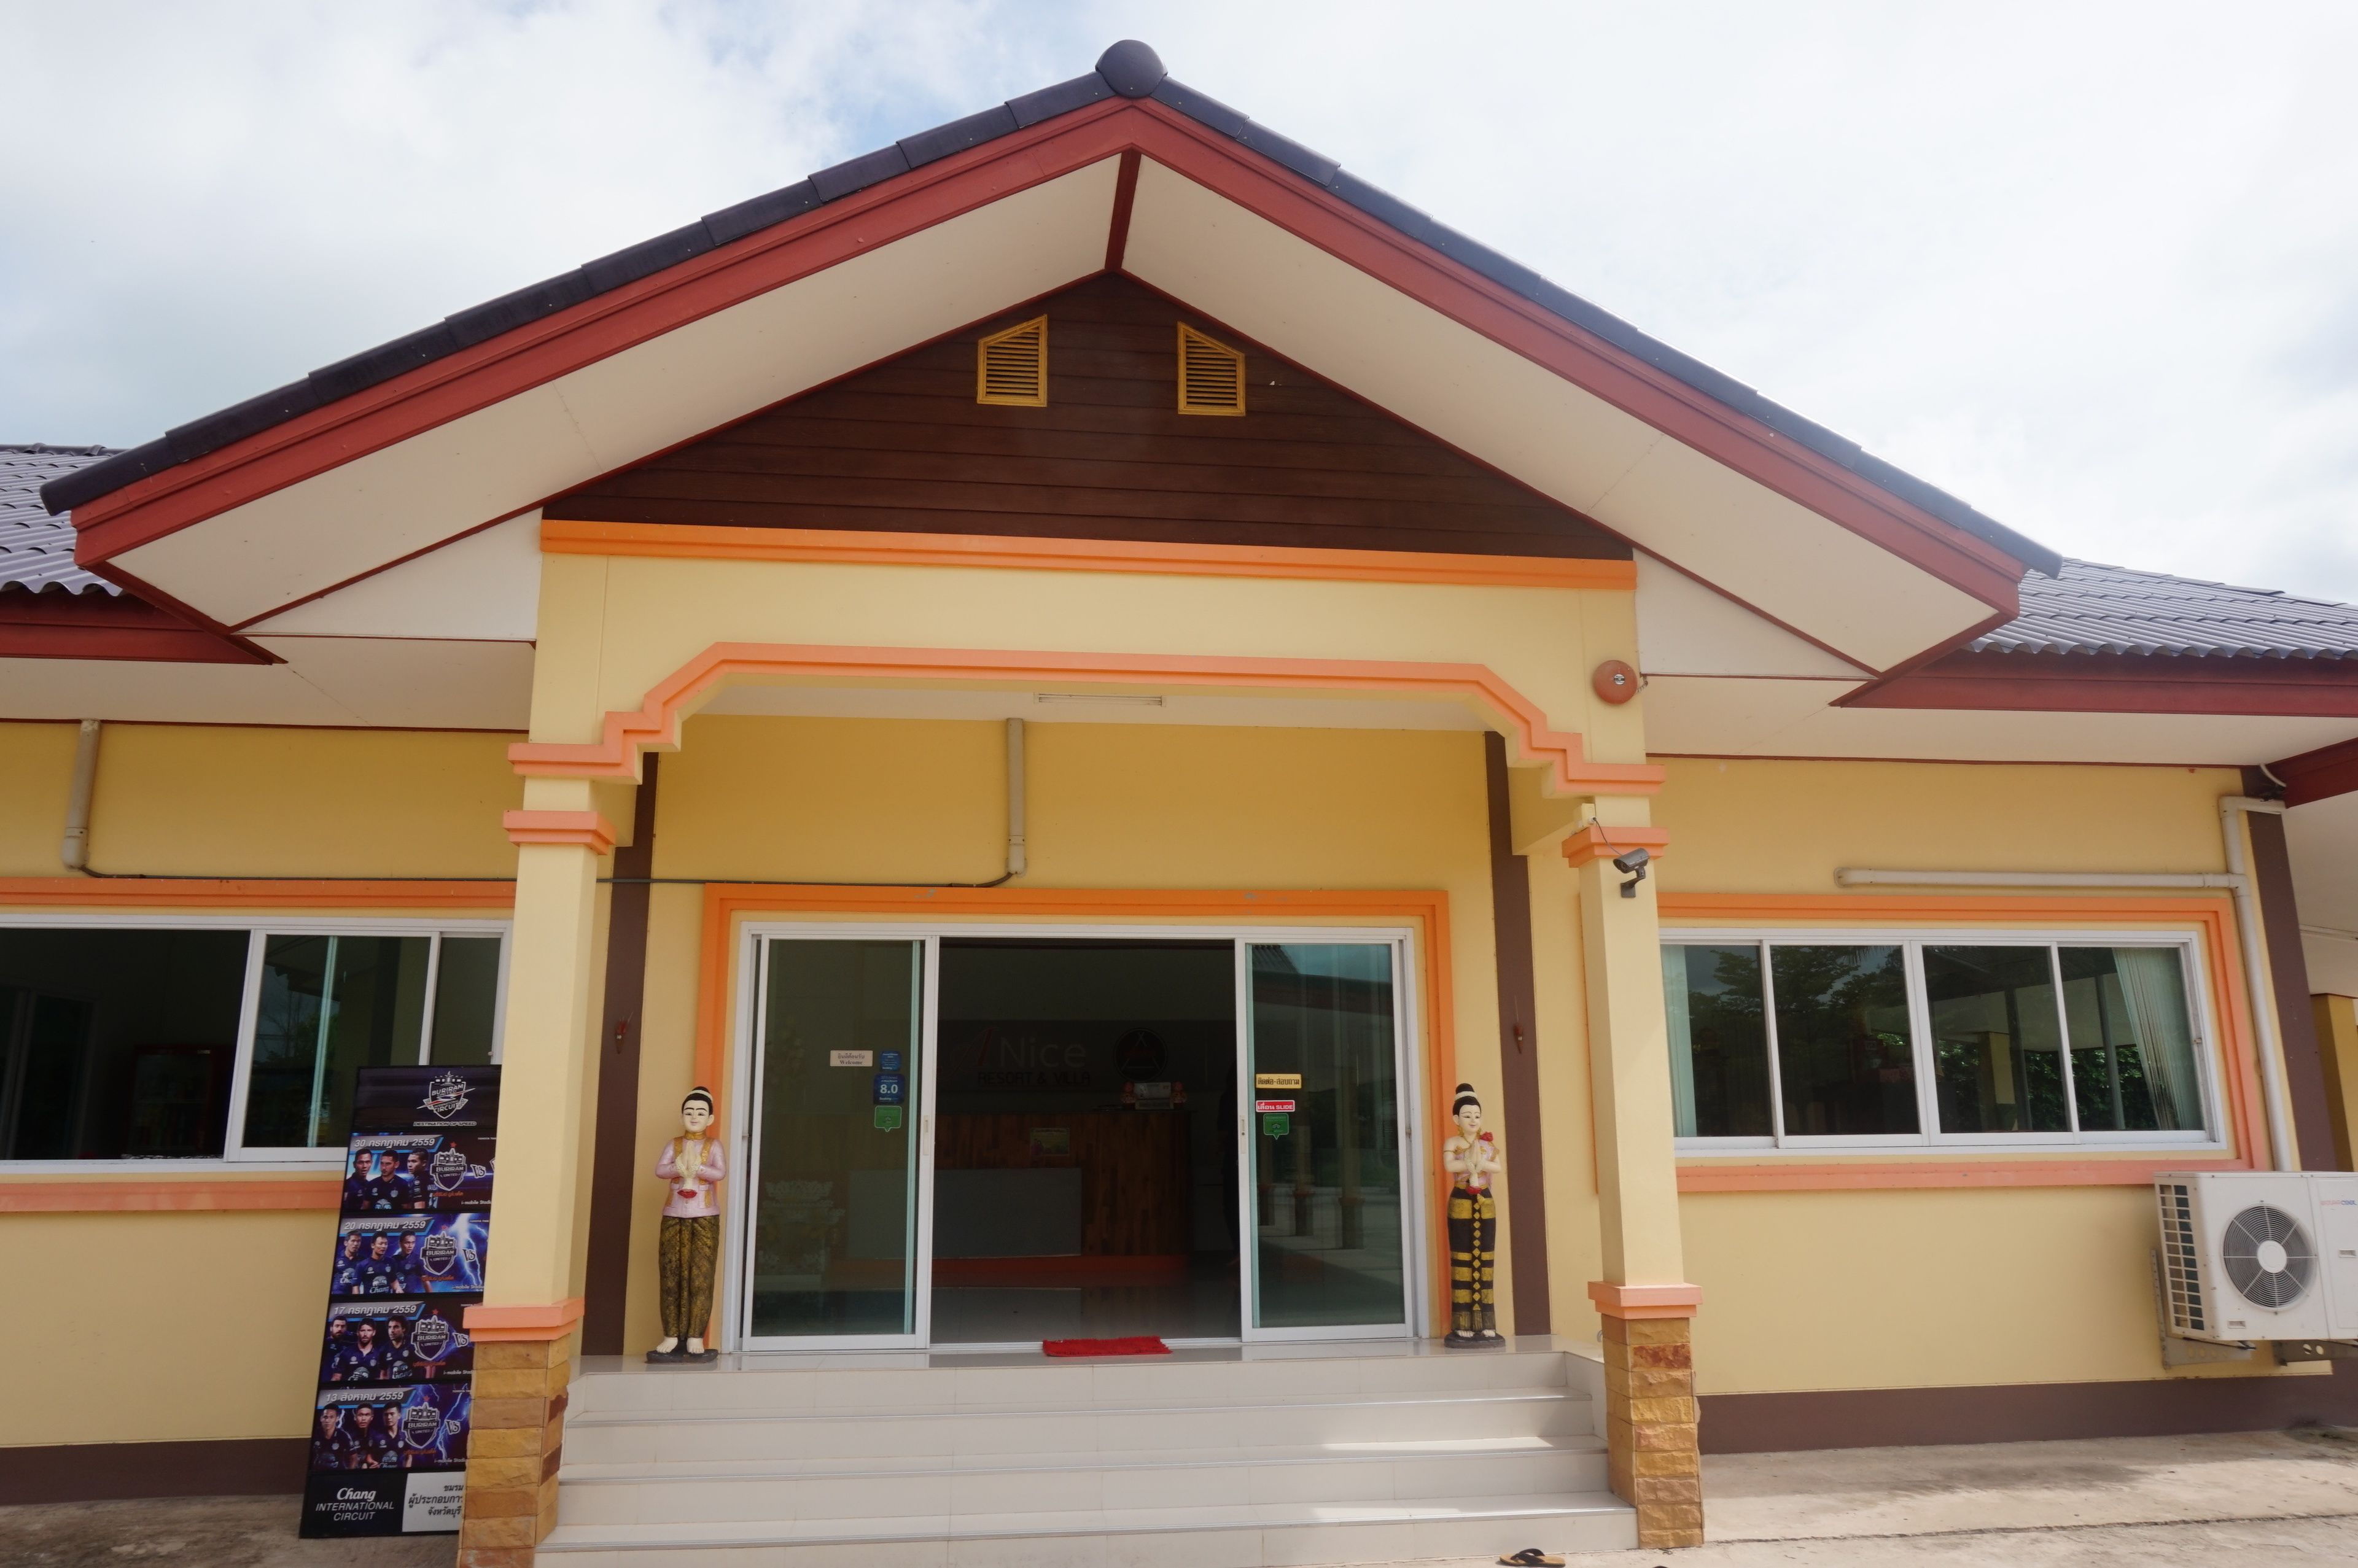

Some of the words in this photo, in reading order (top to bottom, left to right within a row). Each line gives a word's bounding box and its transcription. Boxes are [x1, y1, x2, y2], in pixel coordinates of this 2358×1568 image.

[1000, 1037, 1087, 1068] Nice
[978, 1071, 1033, 1086] RESORT
[1037, 1071, 1048, 1086] &
[1053, 1071, 1091, 1087] VILLA
[432, 1084, 464, 1096] BURIRAM
[880, 1084, 898, 1094] 8.0
[368, 1139, 409, 1149] กรกฎาคม
[470, 1165, 486, 1178] VS
[358, 1221, 400, 1232] กรกฎาคม
[402, 1221, 426, 1229] 2559
[462, 1248, 477, 1262] VS
[348, 1306, 390, 1316] กรกฎาคม
[392, 1305, 417, 1314] 2559
[453, 1332, 469, 1348] VS
[340, 1392, 376, 1402] สิงหาคม
[379, 1392, 403, 1400] 2559
[444, 1419, 461, 1435] VS
[337, 1488, 376, 1502] Chang
[315, 1502, 394, 1512] INTERNATIONAL
[428, 1505, 462, 1518] จังหวัดบุรี
[333, 1512, 376, 1521] CIRCUIT
